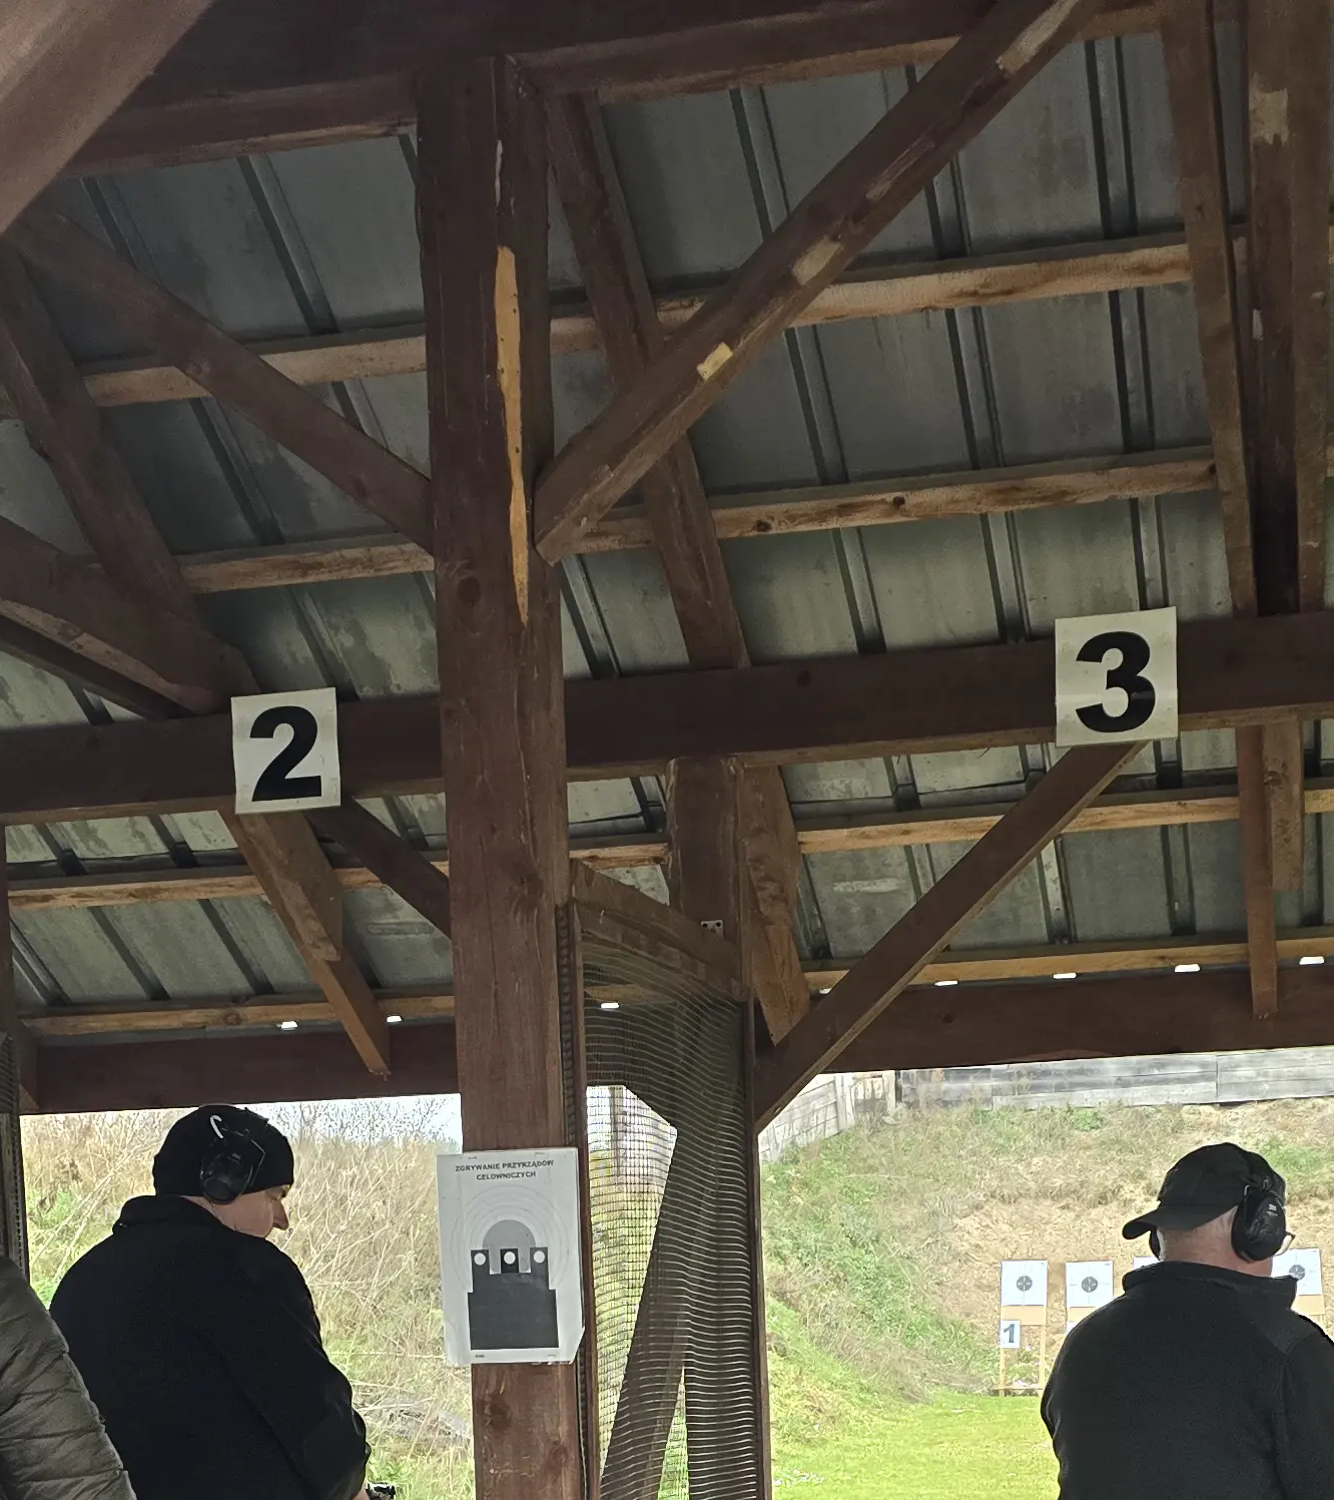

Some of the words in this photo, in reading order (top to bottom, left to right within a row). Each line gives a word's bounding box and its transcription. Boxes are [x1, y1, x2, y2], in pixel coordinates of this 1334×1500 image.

[1075, 631, 1156, 733] 3
[249, 705, 322, 802] 2
[455, 1163, 501, 1172] ZGRYWANIE
[476, 1171, 536, 1181] CELOWNICZYCH
[1003, 1323, 1015, 1343] 1
